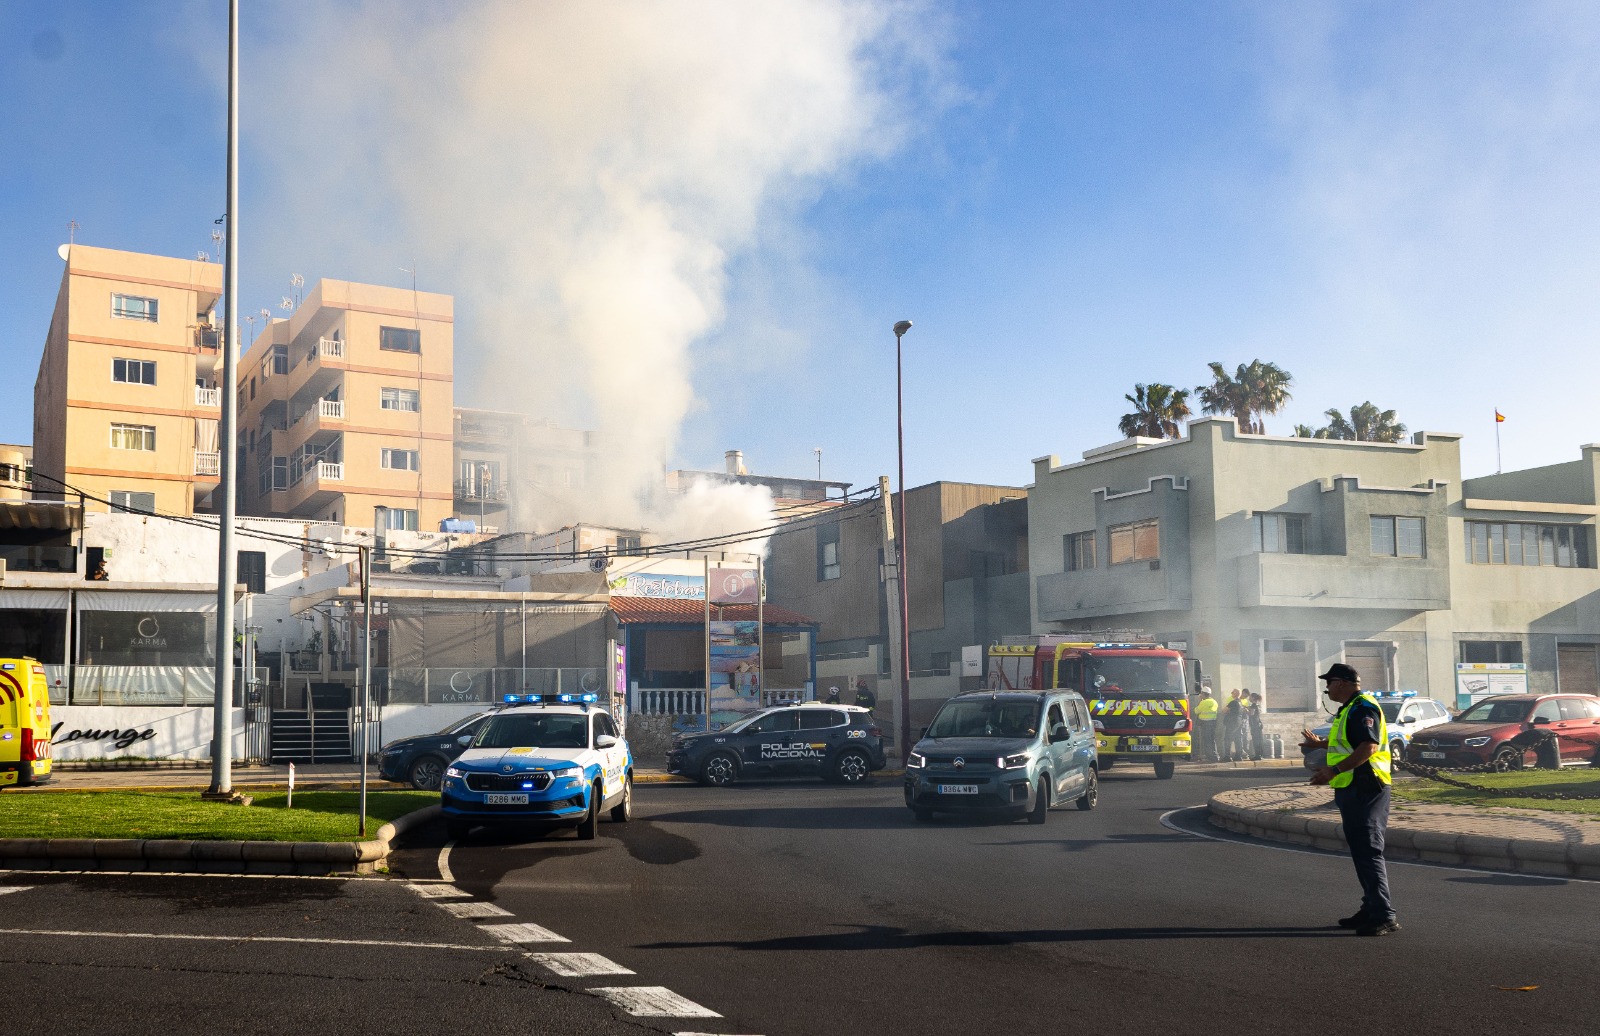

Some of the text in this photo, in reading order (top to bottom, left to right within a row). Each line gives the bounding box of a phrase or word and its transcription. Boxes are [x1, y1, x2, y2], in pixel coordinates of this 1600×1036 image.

[630, 576, 704, 597] Restobar
[130, 638, 167, 646] KARMA
[442, 693, 480, 702] KARMA
[51, 721, 158, 748] Lounge
[761, 750, 826, 759] NACIONAL
[488, 795, 509, 803] 6286
